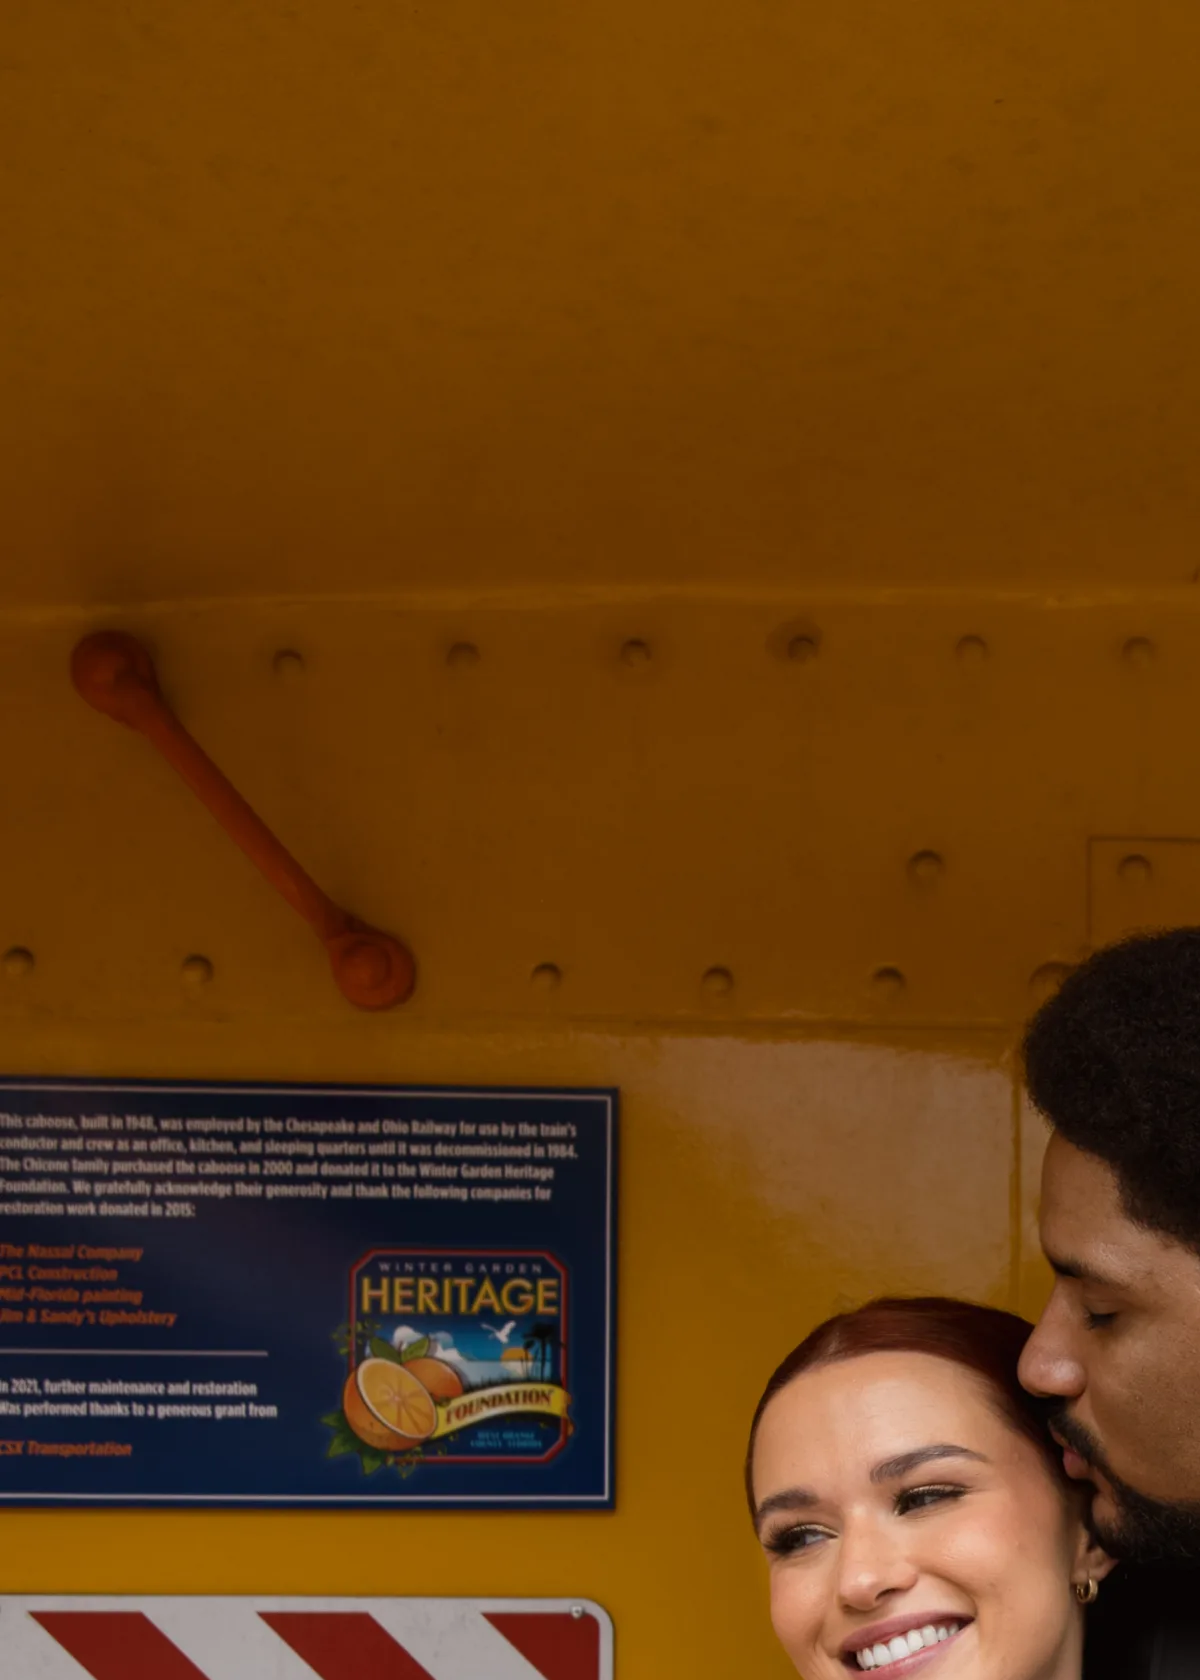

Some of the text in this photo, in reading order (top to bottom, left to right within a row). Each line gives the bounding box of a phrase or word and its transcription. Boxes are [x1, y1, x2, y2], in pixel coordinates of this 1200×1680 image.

[0, 1113, 577, 1137] This caboose, built in 1948, was employed by the Chesapeake and Ohio Railway for use by the train's
[0, 1136, 579, 1157] conductor and crew as an office, kitchen, and sleeping quarters until it was decommissioned in 1984.
[0, 1156, 554, 1181] The Chicone family purchased the caboose in 2000 and donated it to the Winter Garden Heritage
[0, 1179, 551, 1201] Foundation. We gratefully acknowledge their generosity and thank the following companies for
[66, 1202, 97, 1215] work
[99, 1202, 149, 1216] donated
[151, 1202, 163, 1216] in
[0, 1244, 24, 1258] The
[77, 1246, 143, 1261] Company
[27, 1266, 118, 1280] Construction
[378, 1262, 542, 1274] WINTER GARDEN
[82, 1290, 143, 1304] painting
[361, 1276, 558, 1314] HERITAGE
[26, 1309, 37, 1323] &
[40, 1310, 95, 1325] Sandy's
[99, 1311, 178, 1325] Upholstery
[10, 1379, 42, 1394] 2021,
[44, 1380, 86, 1394] further
[88, 1381, 165, 1394] maintenance
[167, 1381, 190, 1395] and
[192, 1382, 258, 1395] restoration
[23, 1401, 88, 1417] performed
[89, 1402, 130, 1416] thanks
[131, 1402, 145, 1416] to
[147, 1405, 155, 1416] a
[157, 1405, 212, 1418] generous
[214, 1404, 246, 1419] grant
[248, 1403, 278, 1417] from
[446, 1389, 551, 1425] FOUNDATION
[27, 1441, 132, 1456] Transportation
